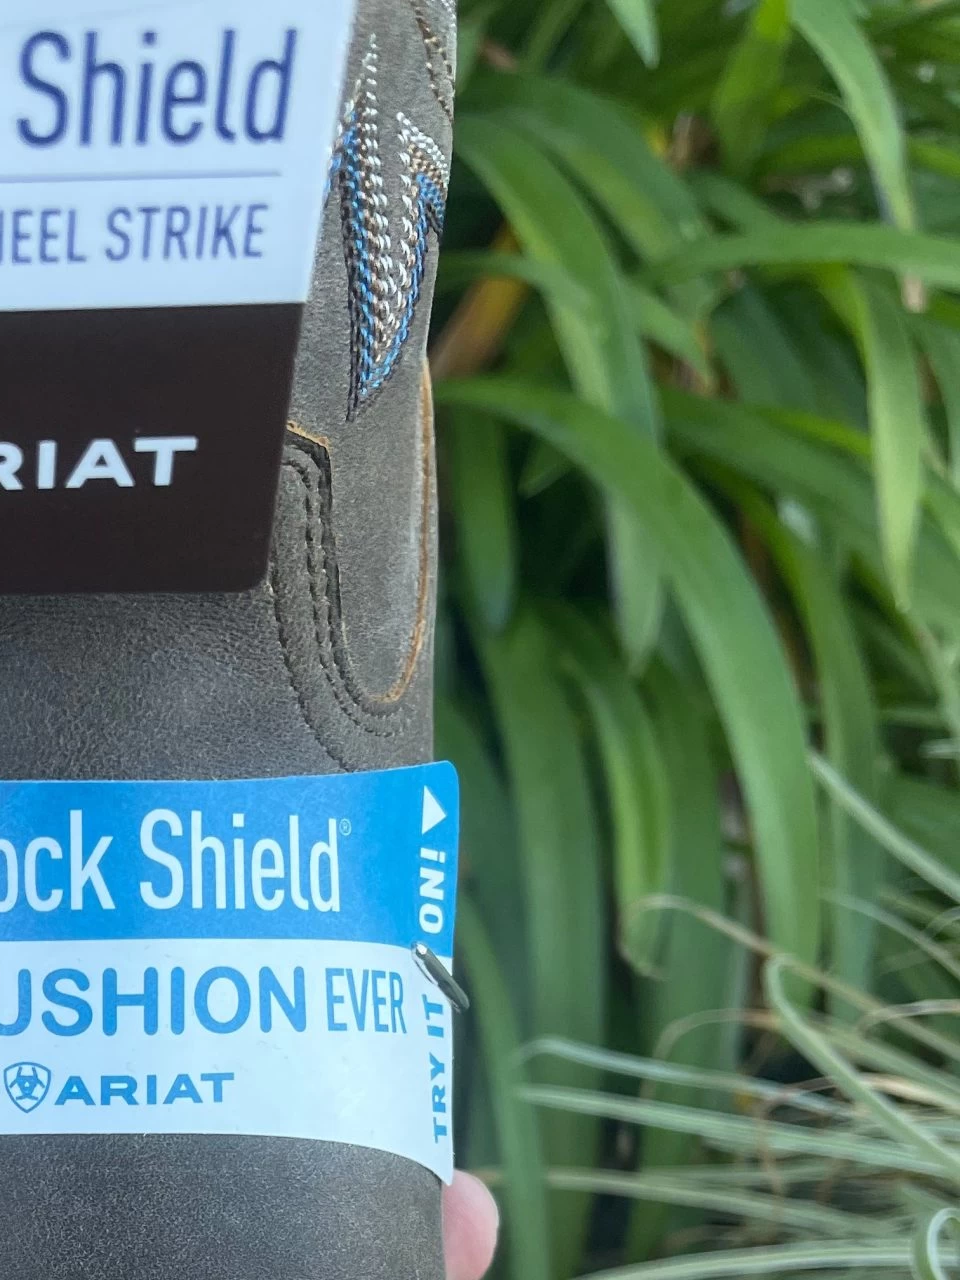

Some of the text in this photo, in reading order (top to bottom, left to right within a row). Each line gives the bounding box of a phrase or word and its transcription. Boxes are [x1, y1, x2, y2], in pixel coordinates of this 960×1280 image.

[16, 28, 297, 148] Shield
[104, 203, 269, 262] STRIKE
[325, 967, 408, 1035] EVER
[418, 847, 448, 1143] TRY IT ON!
[54, 1072, 235, 1106] ARIAT
